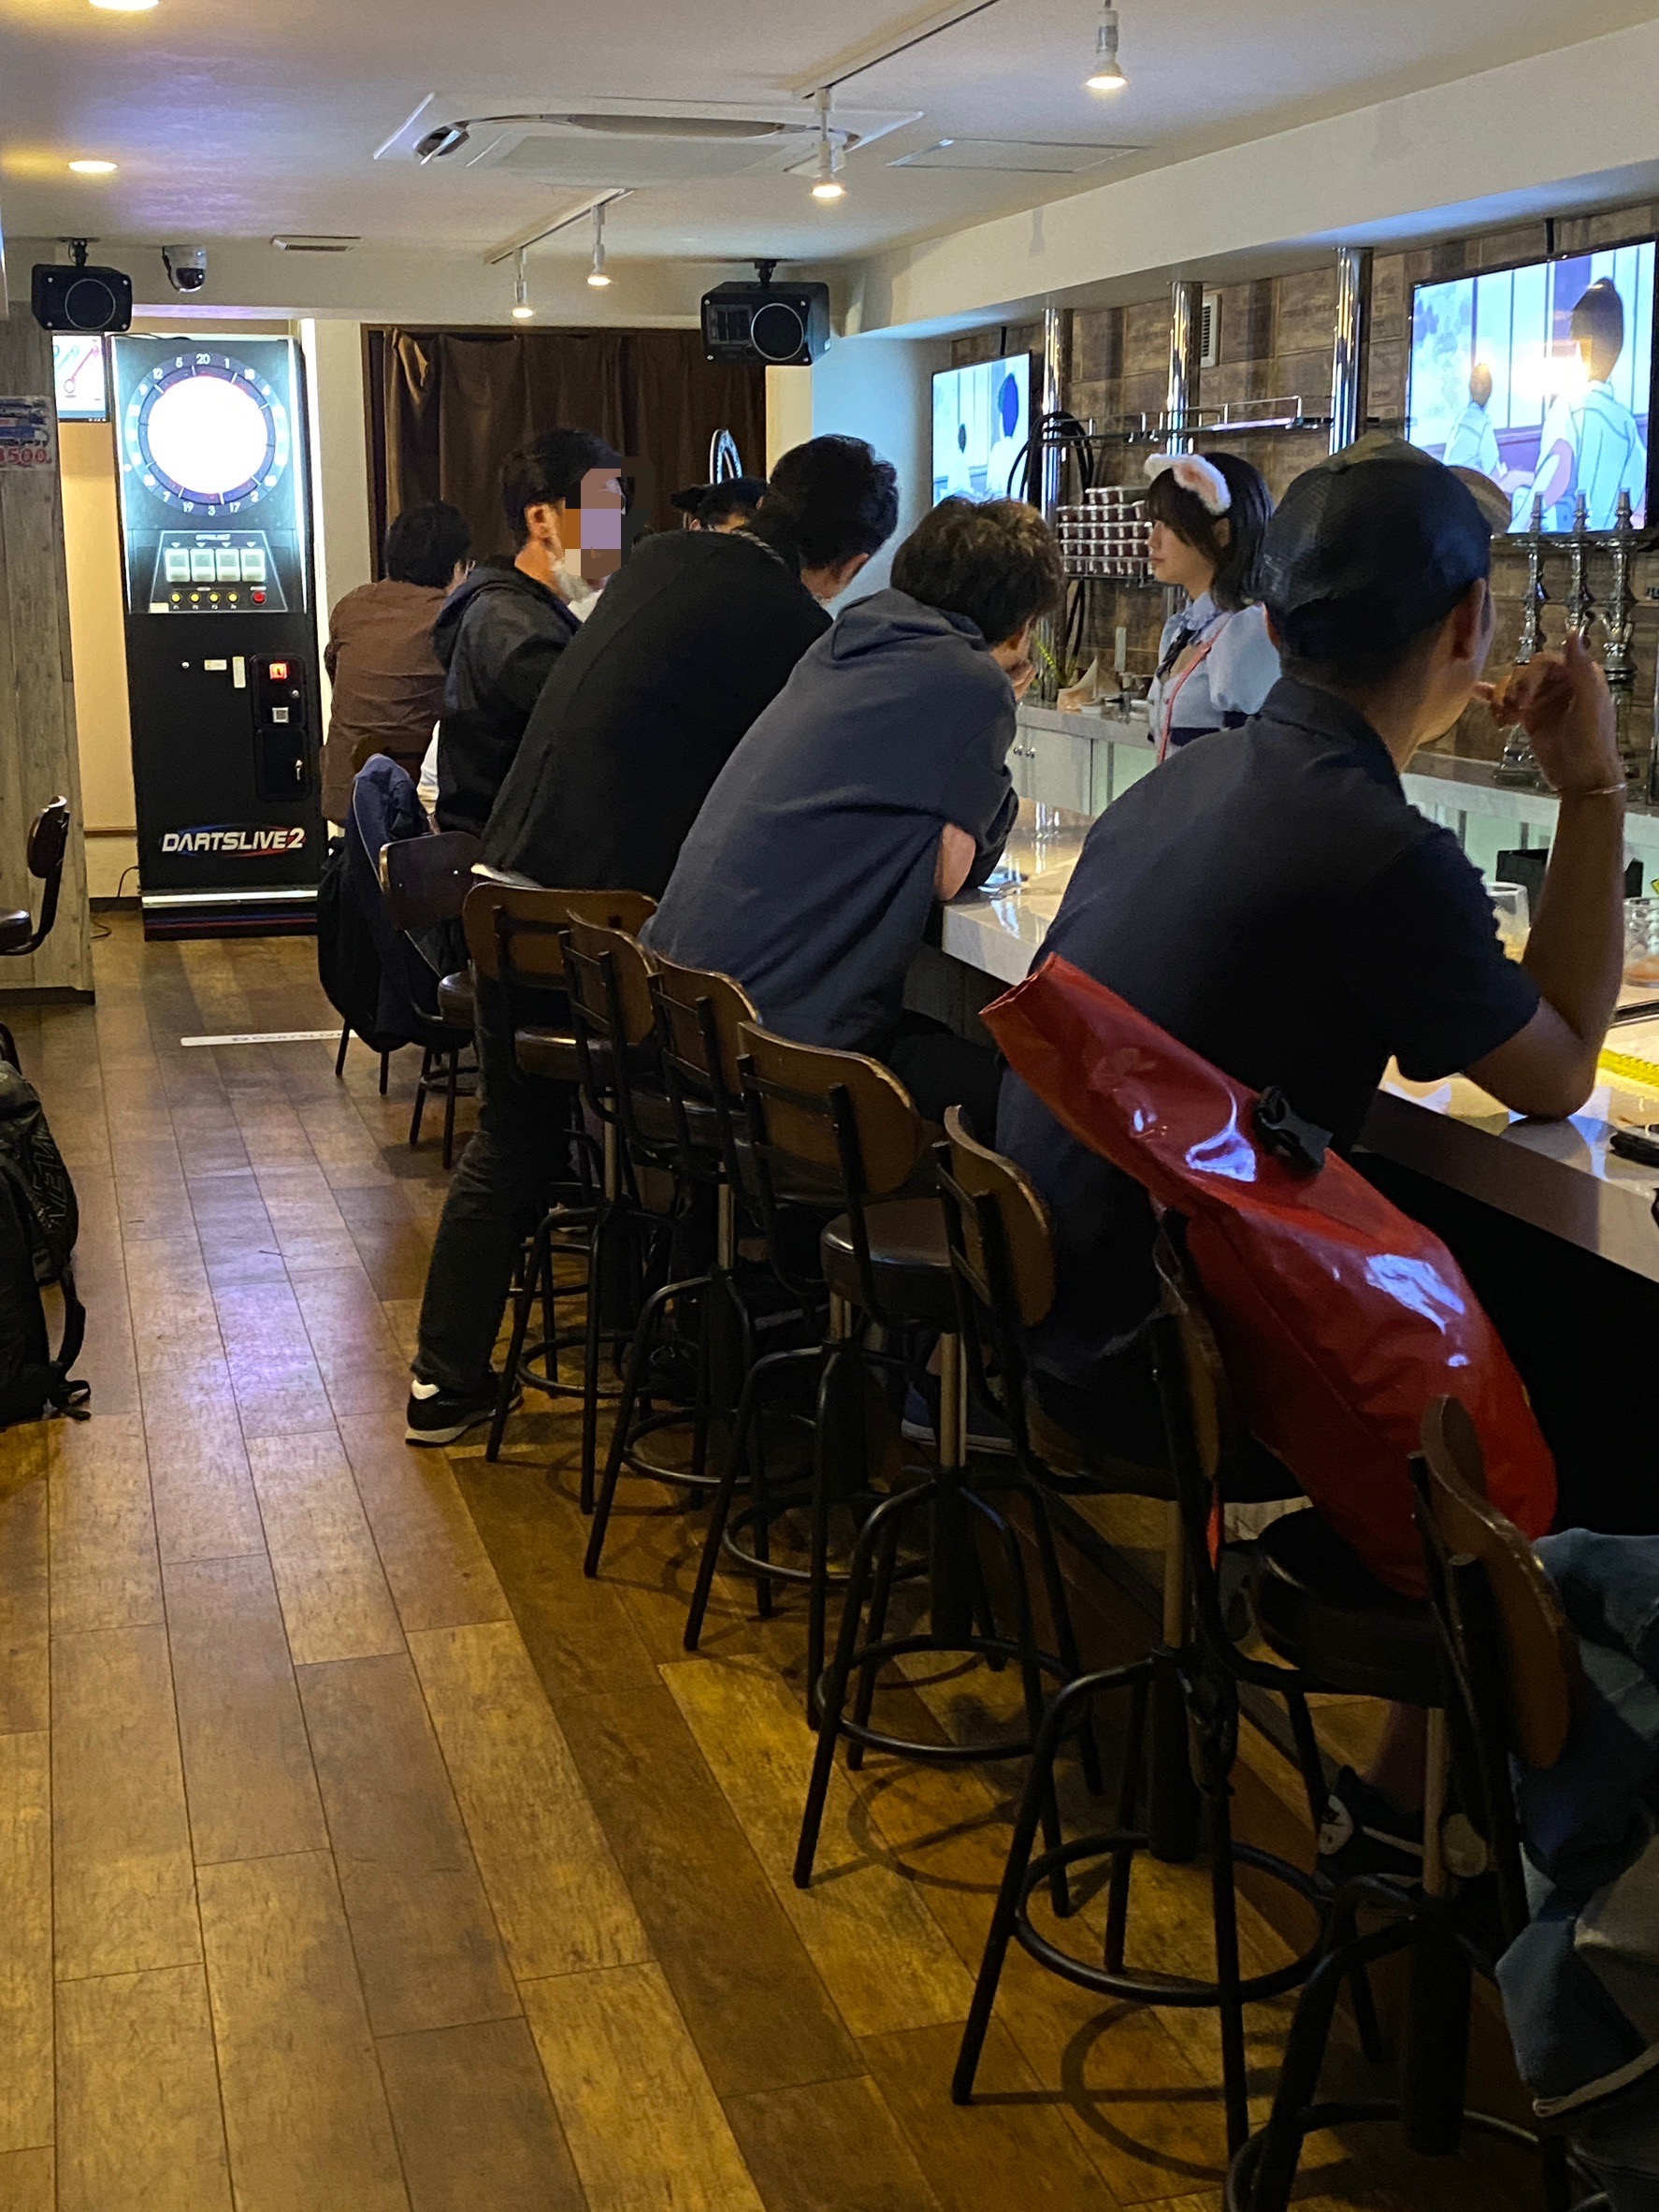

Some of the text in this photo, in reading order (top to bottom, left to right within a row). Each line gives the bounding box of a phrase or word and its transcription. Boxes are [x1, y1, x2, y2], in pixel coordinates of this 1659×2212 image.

[175, 357, 183, 368] 5
[195, 354, 210, 365] 20
[224, 358, 230, 369] 1
[250, 491, 259, 502] 2
[182, 501, 195, 513] 19
[208, 505, 216, 516] 3
[229, 501, 241, 513] 17
